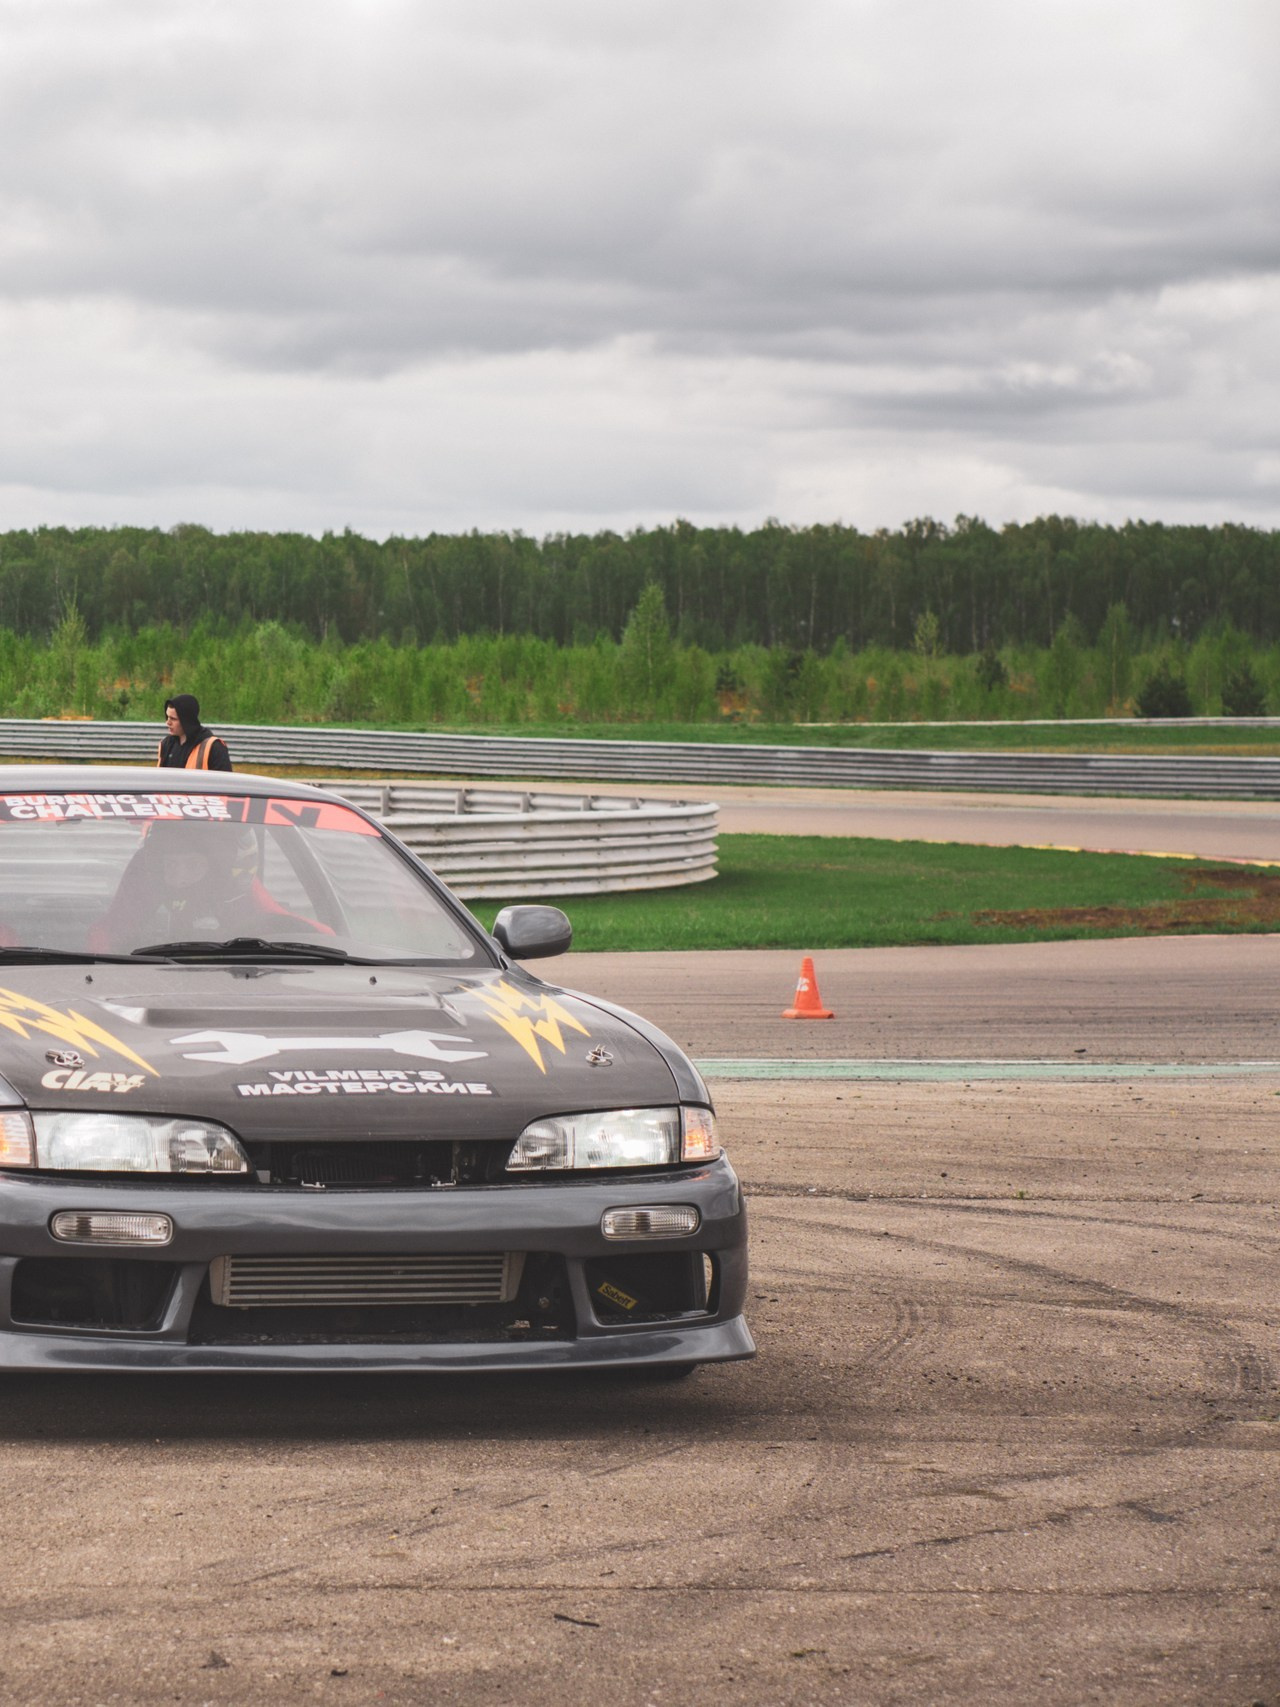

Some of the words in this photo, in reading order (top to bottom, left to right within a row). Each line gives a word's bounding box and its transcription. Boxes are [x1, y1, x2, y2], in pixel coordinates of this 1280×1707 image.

[4, 793, 137, 806] BURNING
[141, 794, 225, 806] TIRES
[10, 803, 232, 819] CHALLENGE
[268, 1070, 445, 1081] VILMER'S
[237, 1081, 492, 1096] МАСТЕРСКИЕ
